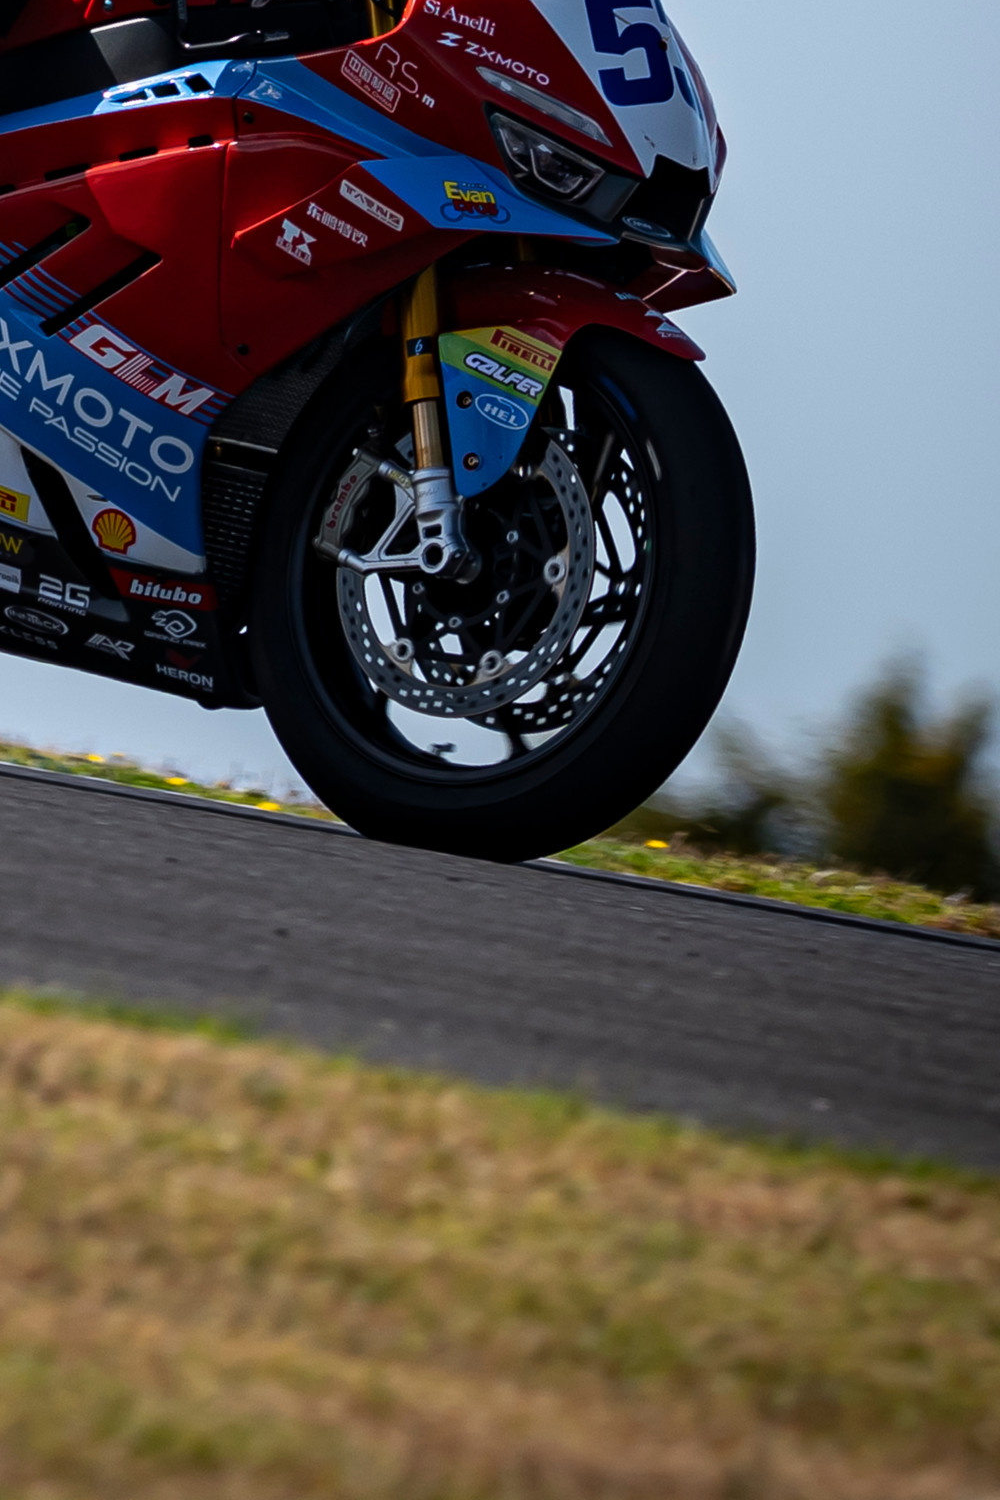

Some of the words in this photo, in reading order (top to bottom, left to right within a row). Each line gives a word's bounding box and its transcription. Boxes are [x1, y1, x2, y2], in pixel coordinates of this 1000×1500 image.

[441, 6, 497, 37] Anelli
[464, 41, 550, 85] ZXMOTO
[444, 181, 496, 205] Evan
[489, 328, 559, 372] PIRELLI
[465, 352, 544, 398] GALFER
[484, 401, 519, 426] HEL
[28, 396, 181, 503] PASSION
[325, 474, 358, 529] brembo
[38, 573, 91, 608] 2G
[129, 578, 202, 605] bitubo
[155, 663, 214, 688] HERON
